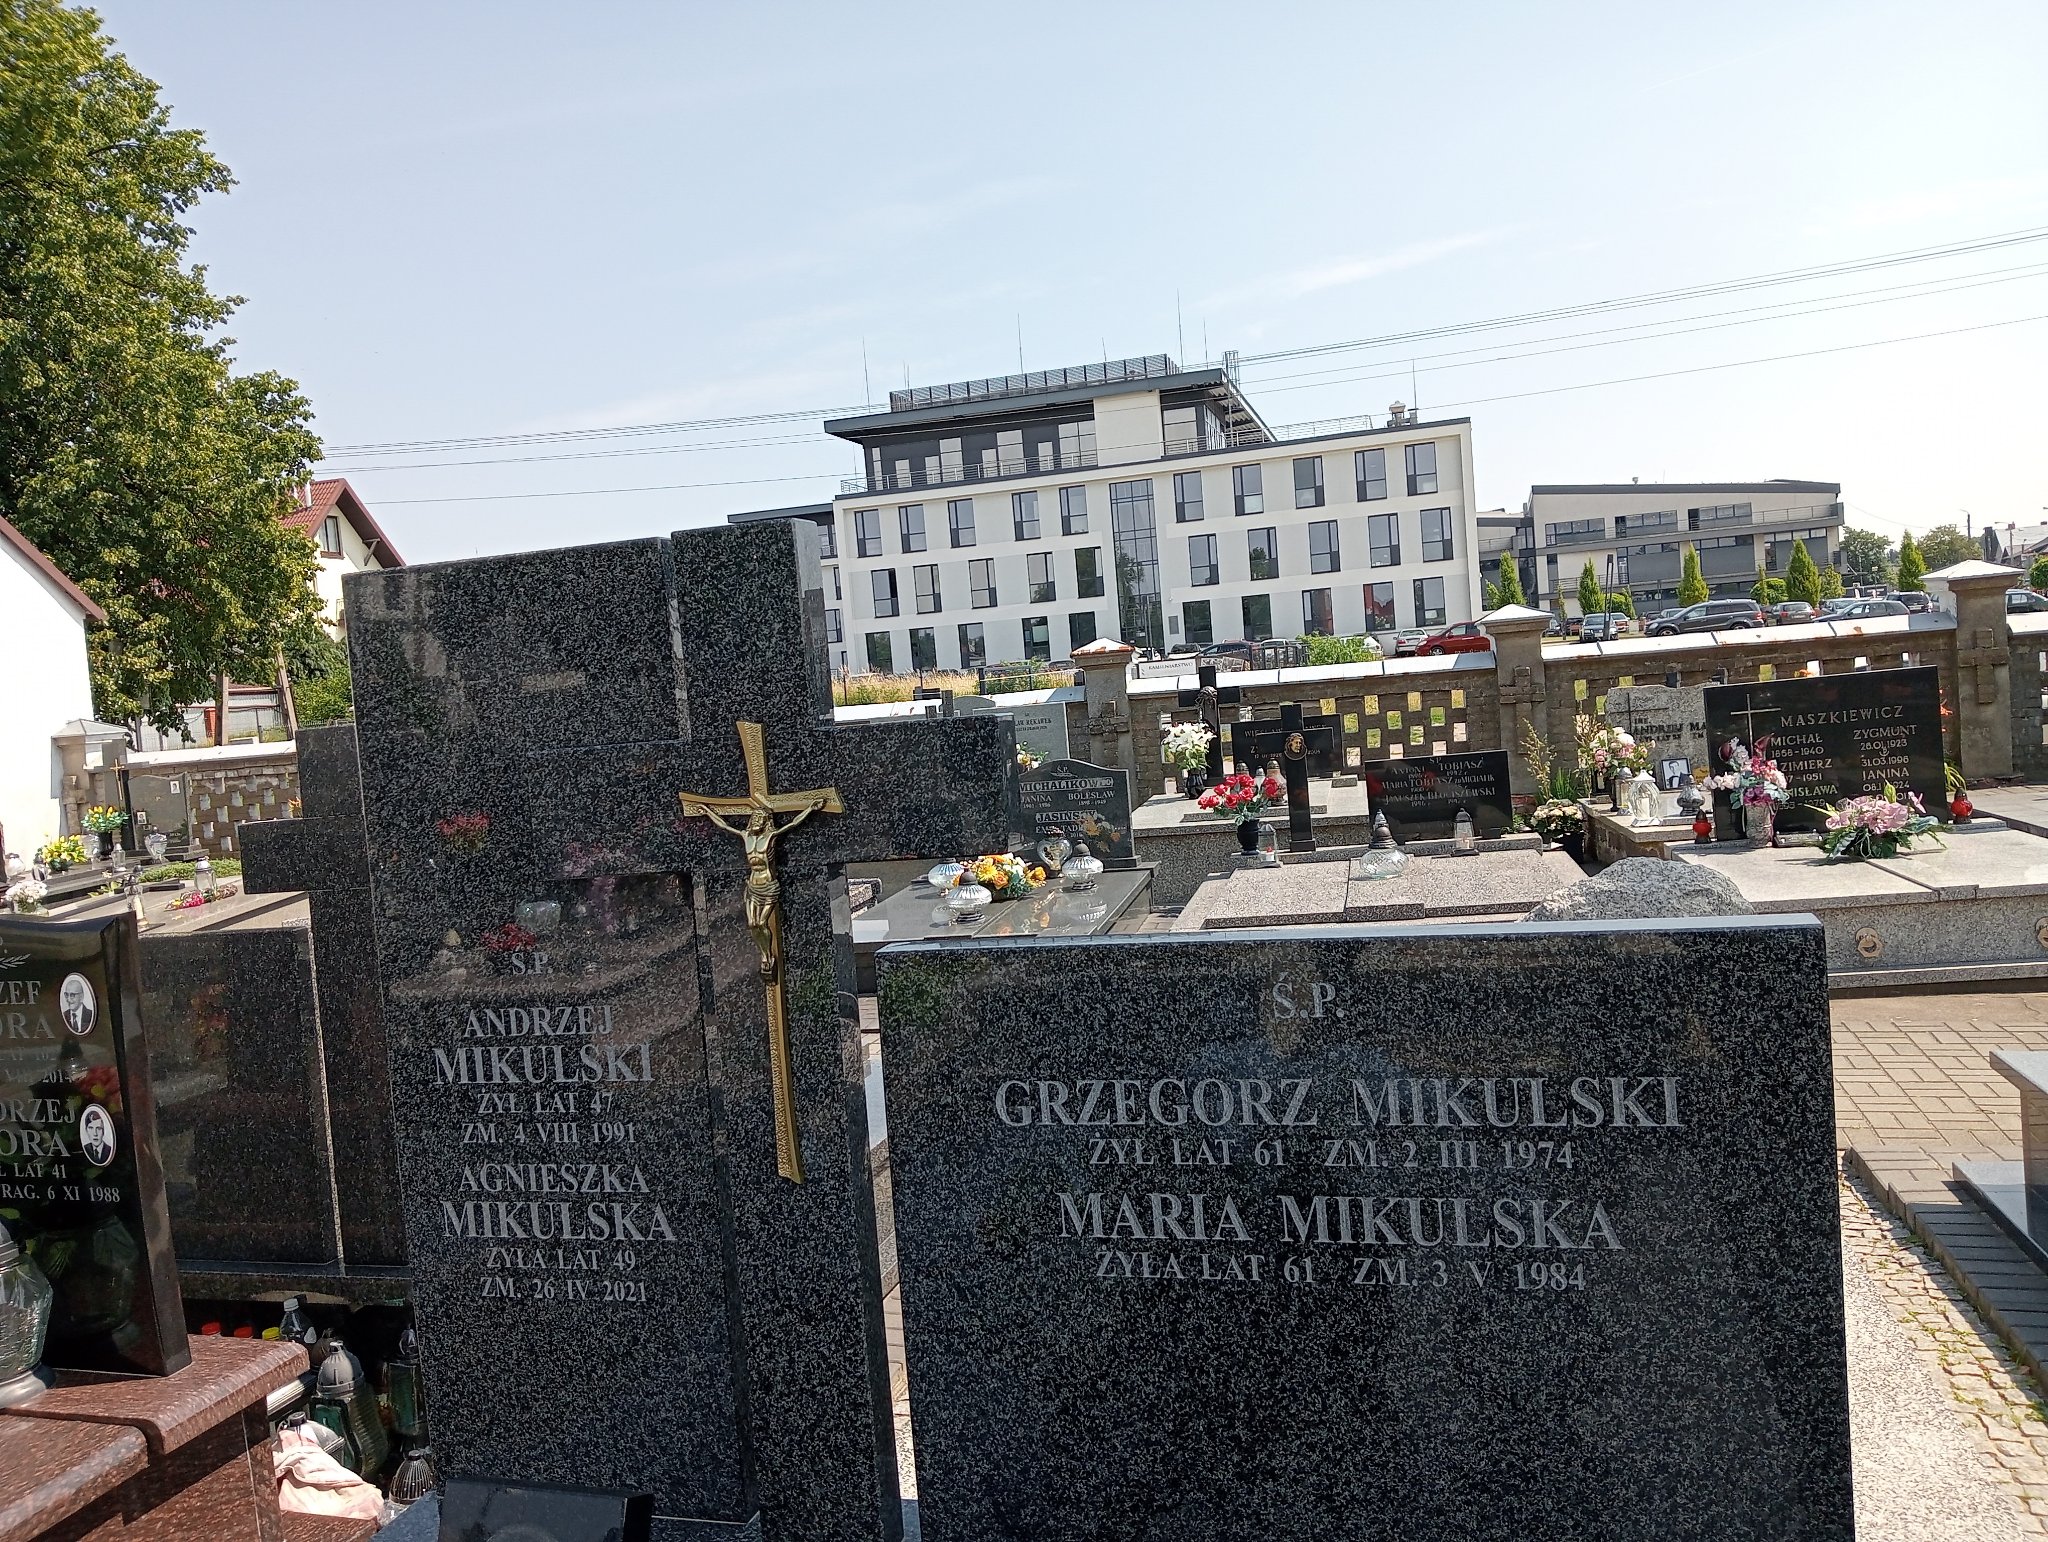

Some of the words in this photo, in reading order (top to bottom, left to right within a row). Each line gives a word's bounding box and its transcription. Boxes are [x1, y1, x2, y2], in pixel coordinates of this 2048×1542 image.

[1781, 705, 1903, 728] MASZKIEWICZ
[1770, 733, 1823, 747] MICHAŁ
[1853, 724, 1917, 740] ZYGMUNT
[1781, 758, 1832, 772] ZIMIERZ
[1788, 784, 1838, 798] NISŁAWA
[1272, 972, 1346, 1019] Ś.P.
[0, 1011, 55, 1039] RA
[463, 1004, 614, 1038] ANDRZEJ
[434, 1042, 656, 1085] MIKULSKI
[477, 1089, 524, 1115] ŻYŁ
[534, 1091, 580, 1115] LAT
[589, 1091, 615, 1117] 47
[995, 1077, 1319, 1128] GRZEGORZ
[1352, 1076, 1684, 1129] MIKULSKI
[462, 1123, 504, 1145] ZM.
[513, 1122, 526, 1145] 4
[534, 1121, 580, 1144] VIII
[592, 1121, 636, 1144] 1991
[1088, 1132, 1154, 1166] ŻYŁ
[1171, 1137, 1236, 1167] LAT
[1254, 1139, 1288, 1168] 61
[1324, 1140, 1389, 1169] ZM.
[1400, 1141, 1419, 1169] 2
[1437, 1140, 1480, 1169] III
[1503, 1141, 1576, 1170] 1974
[14, 1162, 45, 1178] LAT
[52, 1163, 67, 1179] 41
[459, 1163, 651, 1195] AGNIESZKA
[47, 1184, 56, 1200] 6
[63, 1185, 81, 1201] XI
[89, 1186, 121, 1203] 1988
[441, 1200, 677, 1242] MIKULSKA
[1058, 1192, 1254, 1243] MARIA
[1279, 1194, 1627, 1251] MIKULSKA
[486, 1242, 547, 1270] ŻYŁA
[557, 1248, 602, 1271] LAT
[612, 1249, 637, 1272] 49
[1096, 1245, 1186, 1280] ŻYŁA
[1201, 1254, 1265, 1281] LAT
[1283, 1256, 1318, 1284] 61
[1353, 1257, 1420, 1287] ZM.
[1431, 1259, 1449, 1288] 3
[1467, 1260, 1494, 1290] V
[1515, 1261, 1588, 1291] 1984
[480, 1276, 523, 1299] ZM.
[532, 1278, 556, 1300] 26
[566, 1279, 591, 1301] IV
[602, 1280, 648, 1302] 2021
